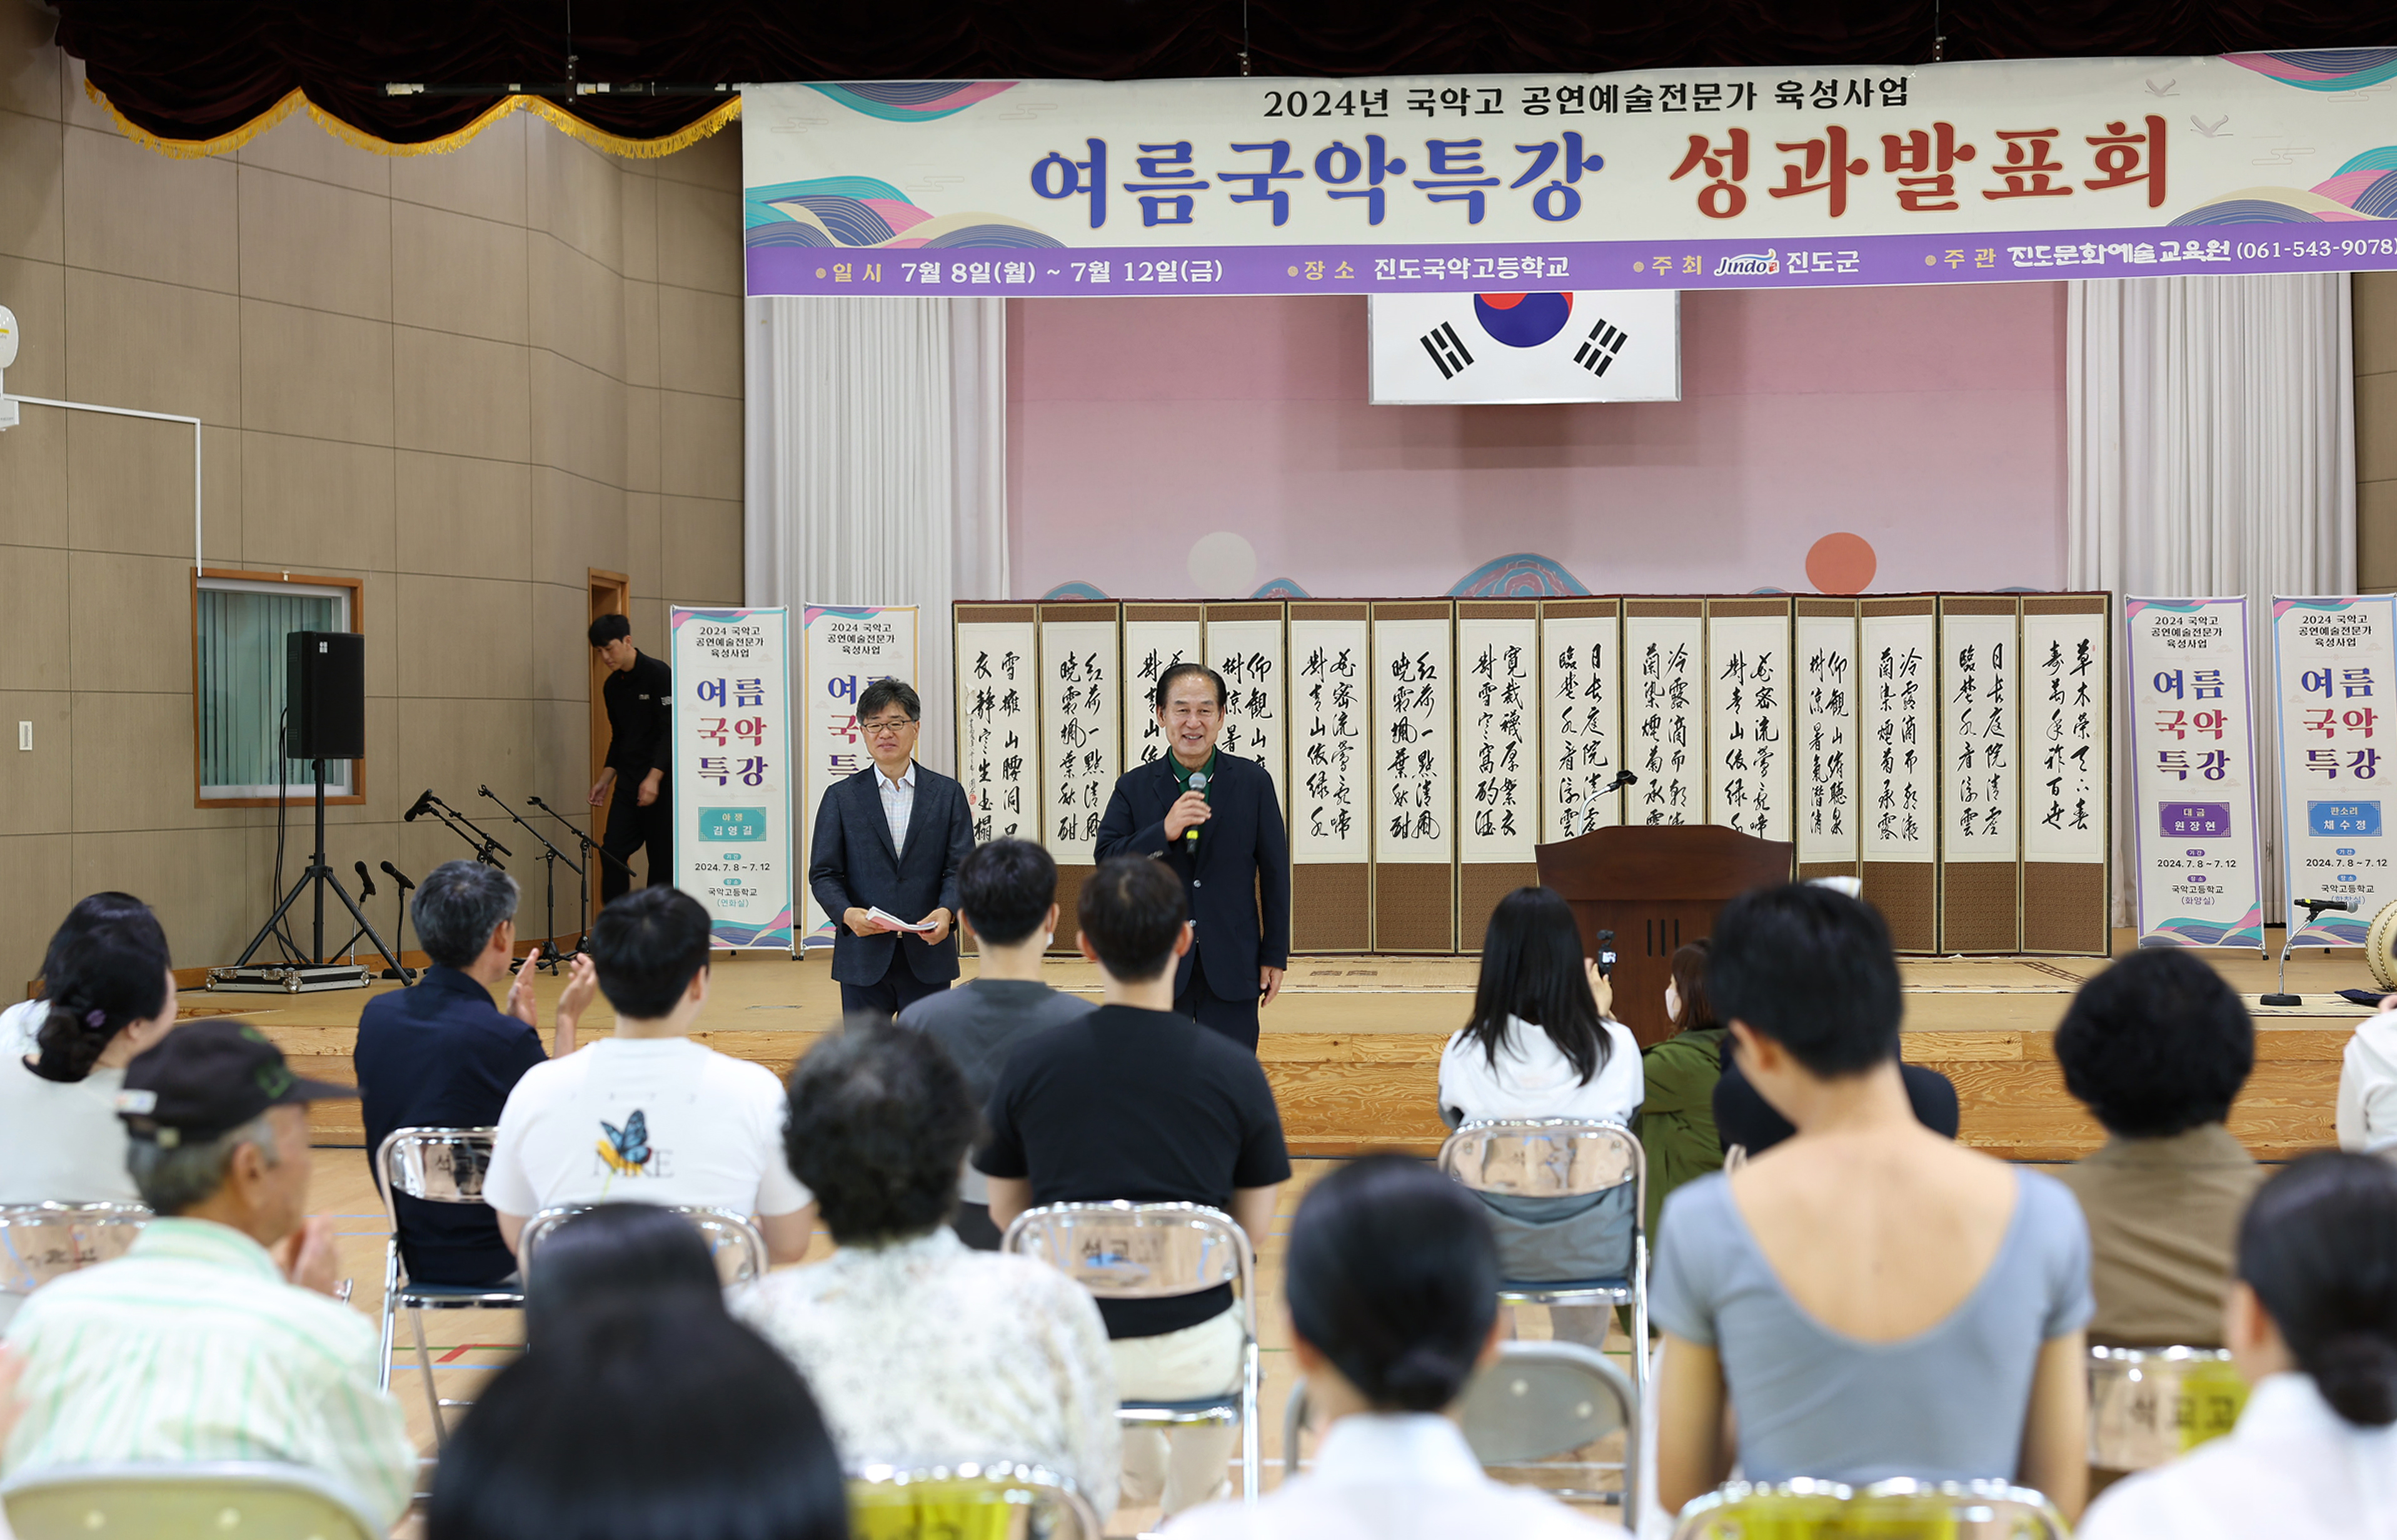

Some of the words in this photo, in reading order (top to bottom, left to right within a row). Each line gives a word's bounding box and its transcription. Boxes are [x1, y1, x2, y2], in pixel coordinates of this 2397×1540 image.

[1264, 88, 1389, 118] 2024년
[1407, 87, 1504, 118] 국악고
[1521, 82, 1758, 116] 공연예술전문가
[1774, 76, 1909, 110] 육성사업
[1030, 131, 1604, 229] 여름국악특강
[1669, 114, 2167, 219] 성과발표회
[1715, 257, 1768, 275] Jindo
[1786, 250, 1861, 274] 진도군
[2007, 239, 2232, 268] 진도문화예술교육원
[901, 261, 942, 284] 7월
[950, 261, 1037, 284] 8일(월)
[1070, 260, 1112, 283] 7월
[1124, 259, 1224, 283] 12일(금)
[1374, 255, 1571, 281] 진도국악고등학교
[832, 622, 858, 632] 2024
[863, 623, 892, 632] 국악고
[2155, 616, 2184, 625] 2024
[2189, 616, 2219, 626] 국악고
[2303, 615, 2331, 624] 2024
[2337, 614, 2368, 624] 국악고
[696, 637, 764, 647] 공연예술전문가
[699, 626, 727, 636] 2024
[731, 626, 761, 636] 국악고
[827, 634, 895, 644] 공연예술전문가
[2151, 627, 2223, 637] 공연예술전문가
[2299, 626, 2372, 636] 공연예술전문가
[711, 648, 750, 658] 육성사업
[842, 645, 881, 655] 육성사업
[2166, 638, 2207, 649] 육성사업
[2314, 638, 2356, 648] 육성사업
[696, 676, 765, 708] 여름
[2153, 668, 2225, 701] 여름
[2301, 667, 2376, 700] 여름
[696, 715, 767, 747] 국악
[827, 714, 859, 744] 국
[2154, 708, 2228, 741] 국악
[2302, 707, 2379, 740] 국악
[696, 755, 769, 787] 특강
[827, 754, 860, 776] 특
[2156, 748, 2231, 781] 특강
[2304, 747, 2382, 781] 특강
[2330, 806, 2358, 816] 판소리
[708, 887, 758, 896] 국악고등학교
[2171, 885, 2224, 894] 국악고등학교
[2321, 884, 2374, 894] 국악고등학교
